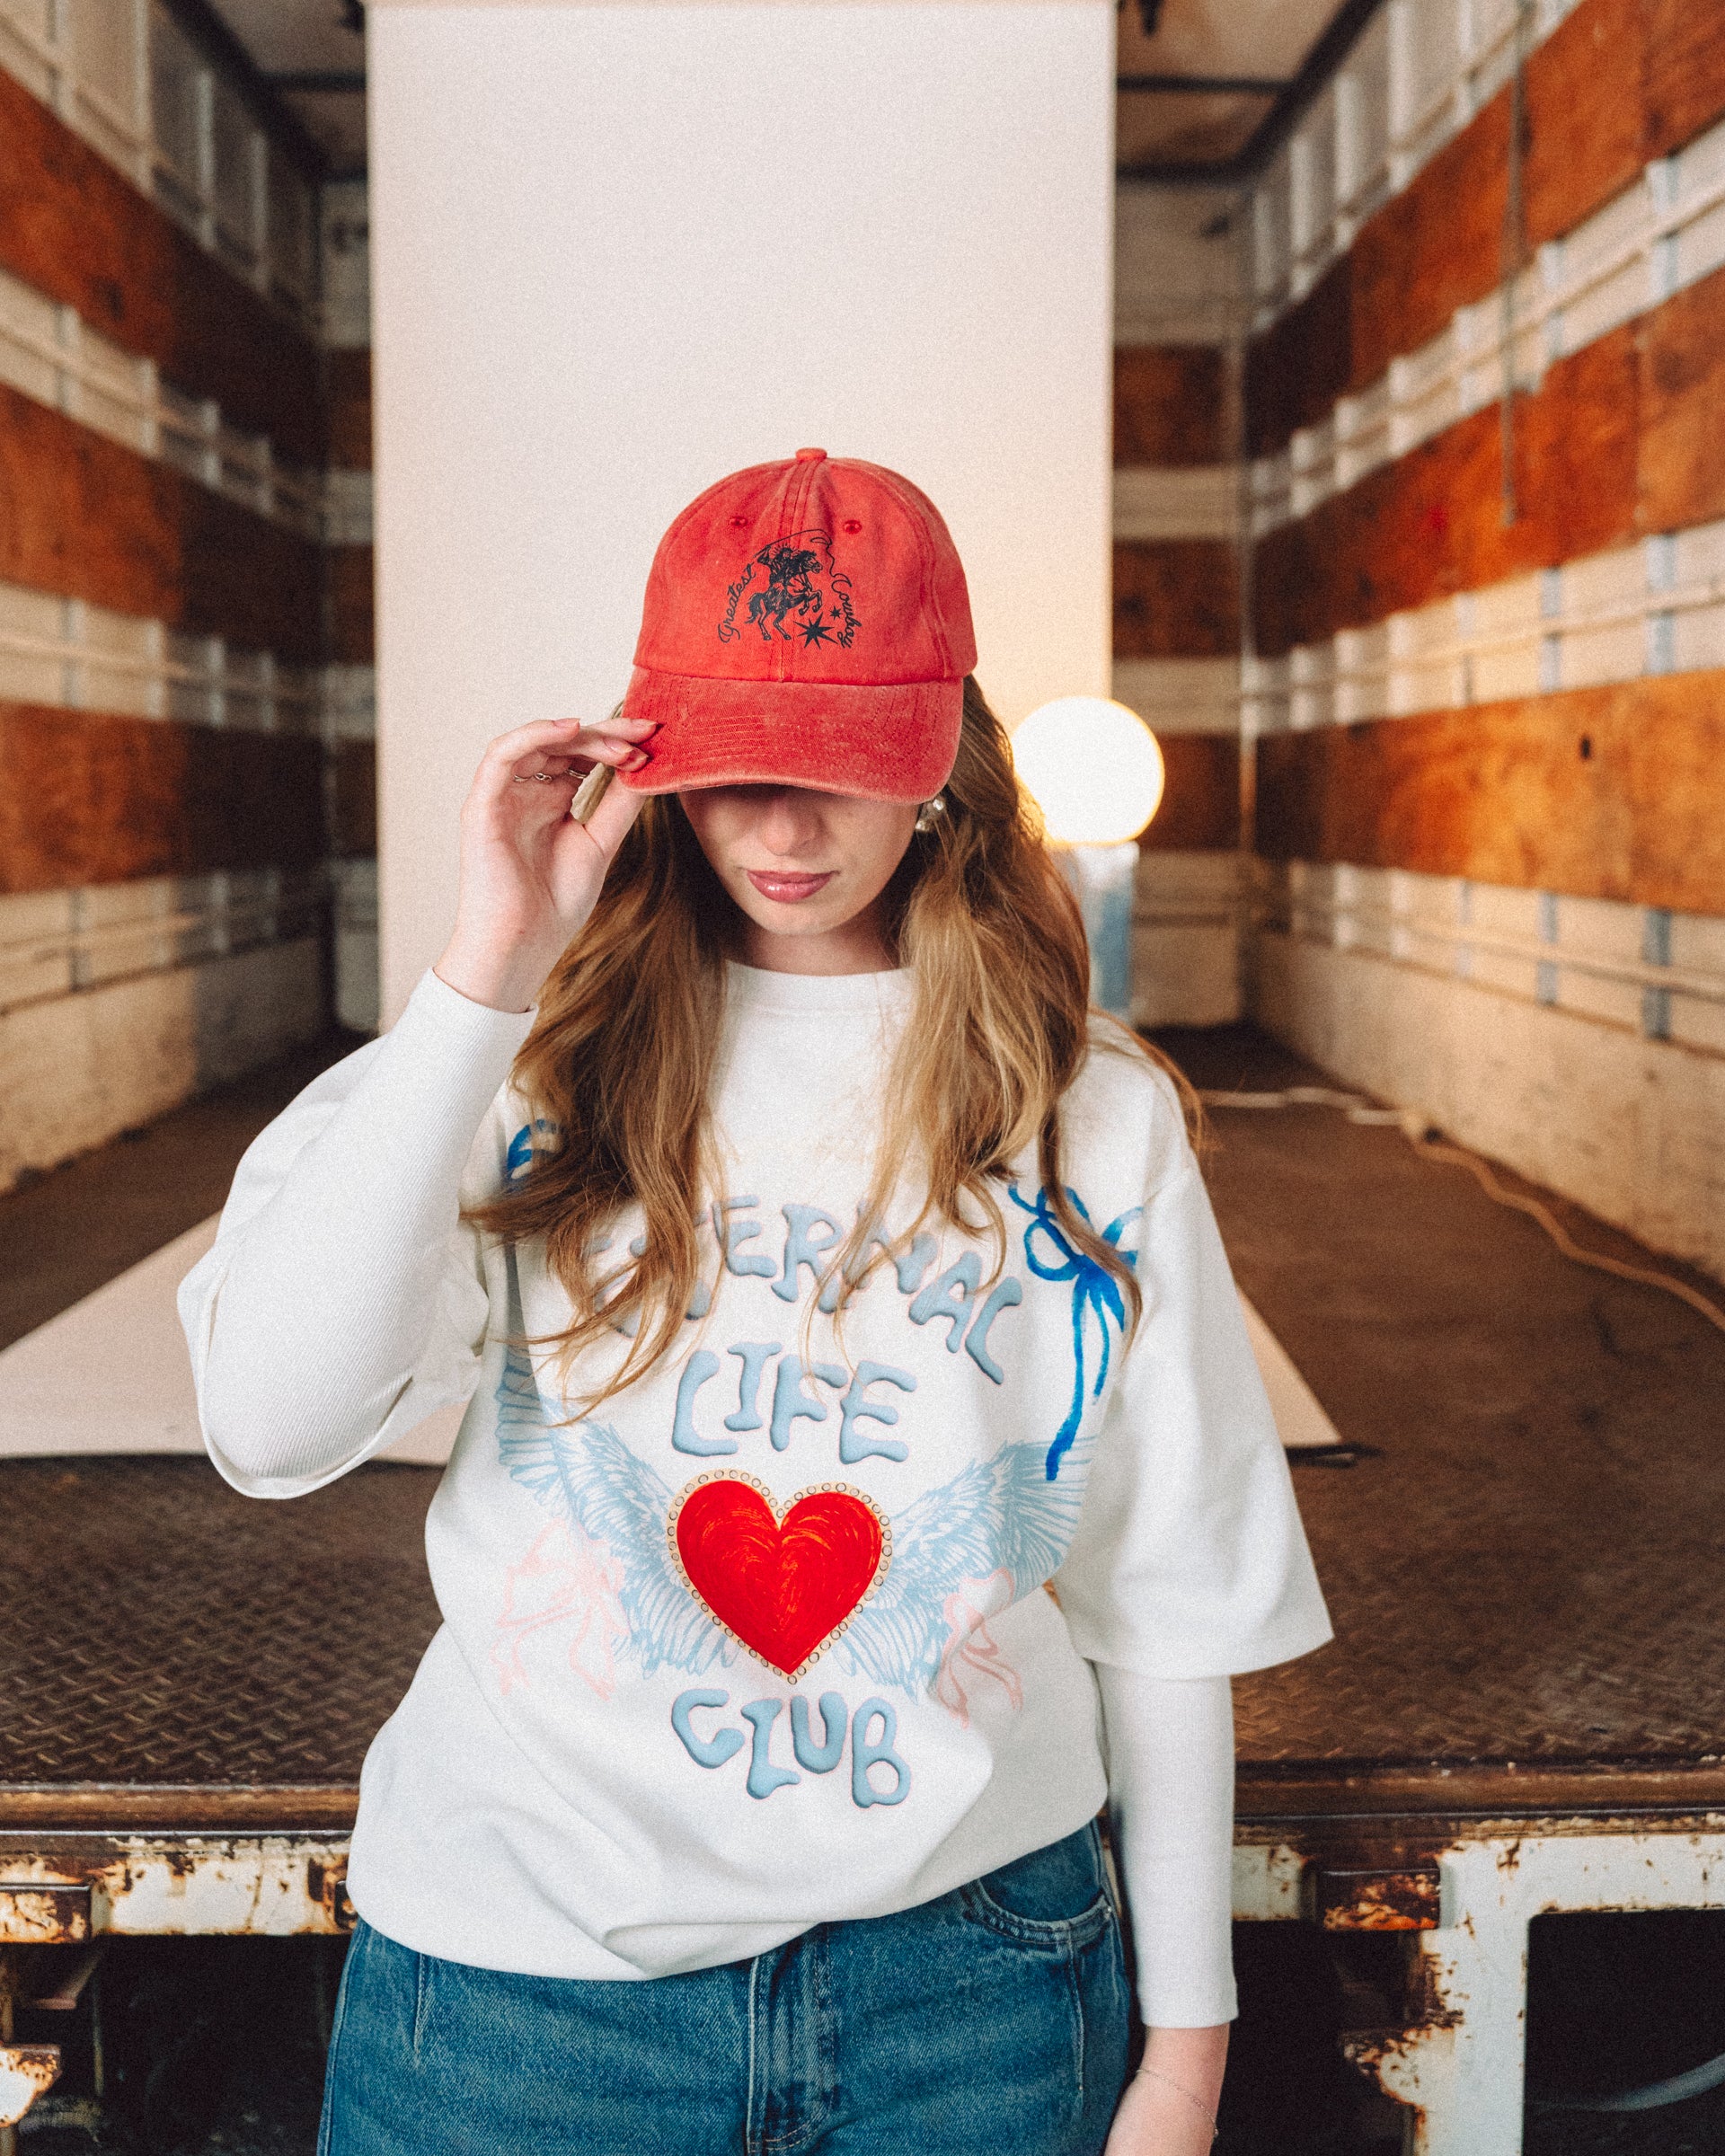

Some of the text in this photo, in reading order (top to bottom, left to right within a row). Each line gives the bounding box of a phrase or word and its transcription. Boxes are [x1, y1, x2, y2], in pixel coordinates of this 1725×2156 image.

[718, 561, 862, 649] Greatest Cowboy
[584, 1195, 1022, 1384] ERNAL
[671, 1341, 917, 1464] LIFE
[671, 1688, 912, 1808] CLUB
